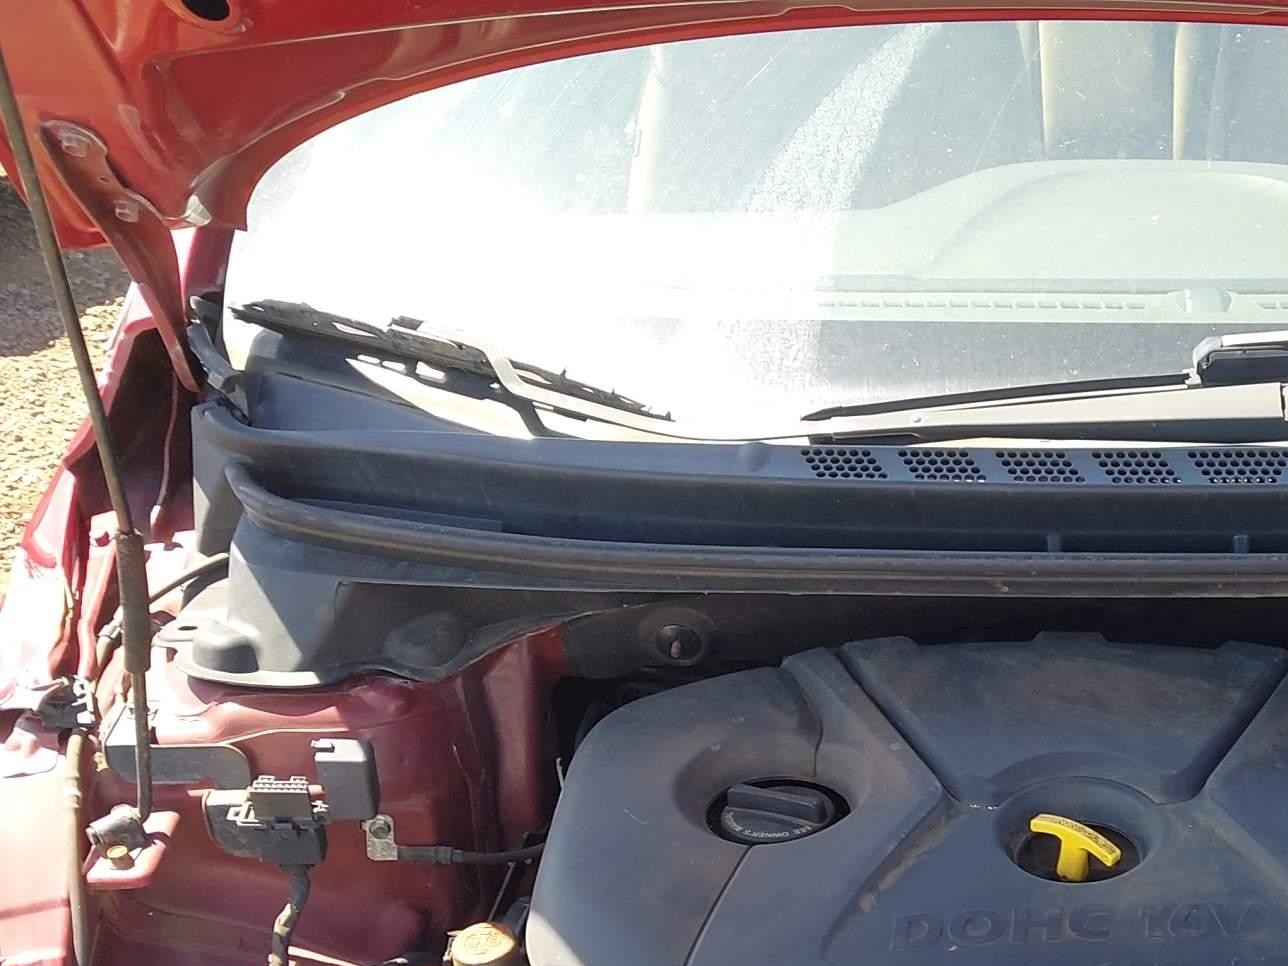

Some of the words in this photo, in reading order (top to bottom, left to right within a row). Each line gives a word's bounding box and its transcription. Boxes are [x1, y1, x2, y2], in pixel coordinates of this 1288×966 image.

[743, 829, 790, 839] OWNER'S
[890, 906, 1114, 951] DOHC
[1137, 903, 1266, 943] 16V
